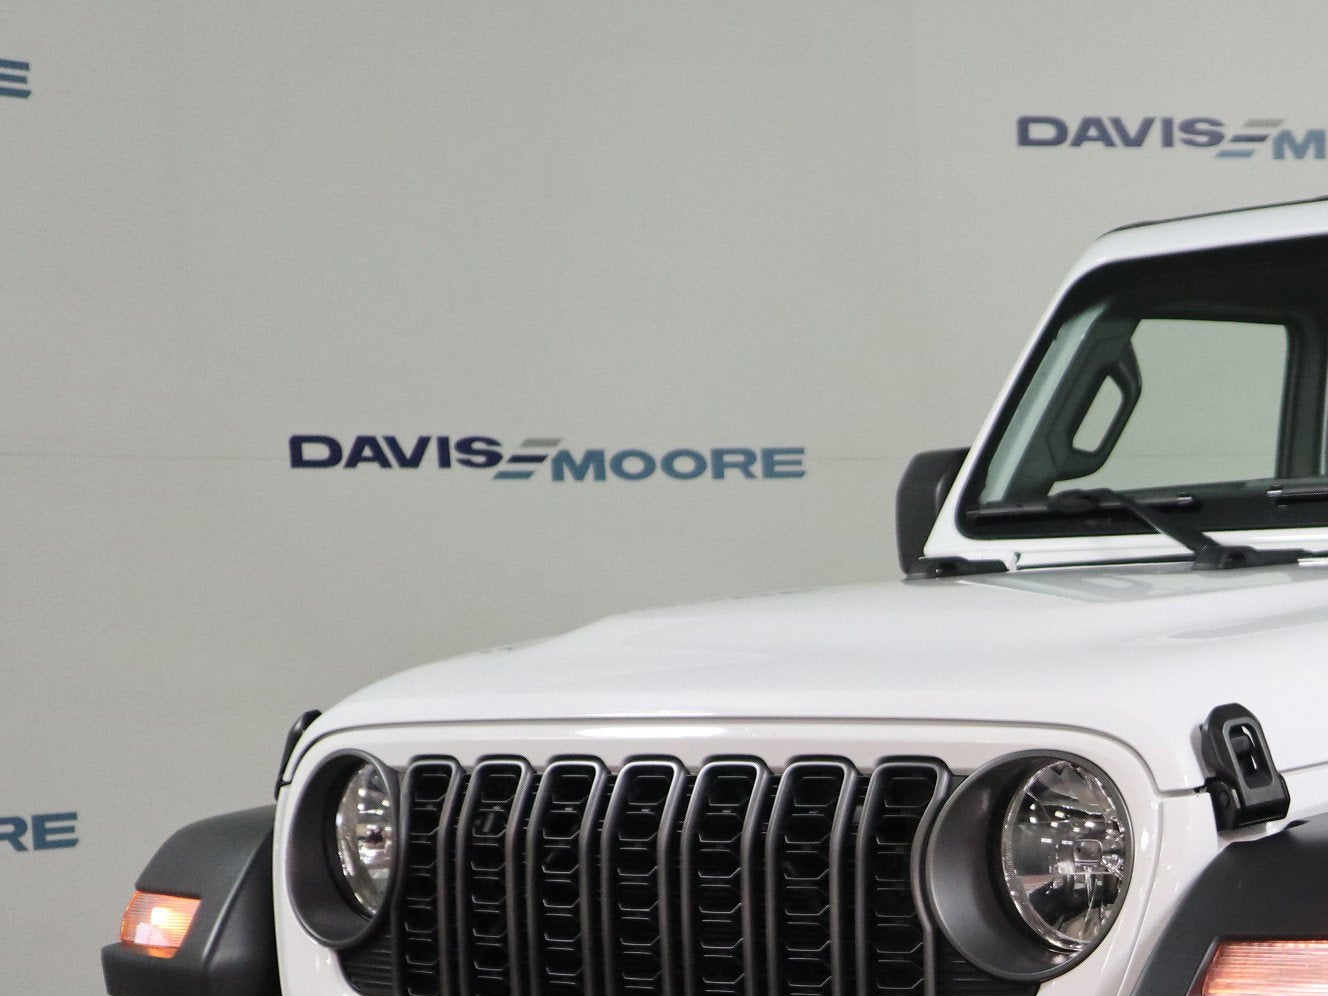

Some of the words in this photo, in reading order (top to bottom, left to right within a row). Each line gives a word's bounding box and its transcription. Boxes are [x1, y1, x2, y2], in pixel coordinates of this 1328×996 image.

[1015, 115, 1225, 148] DAVIS
[288, 435, 505, 469] DAVIS
[550, 446, 806, 481] MOORE
